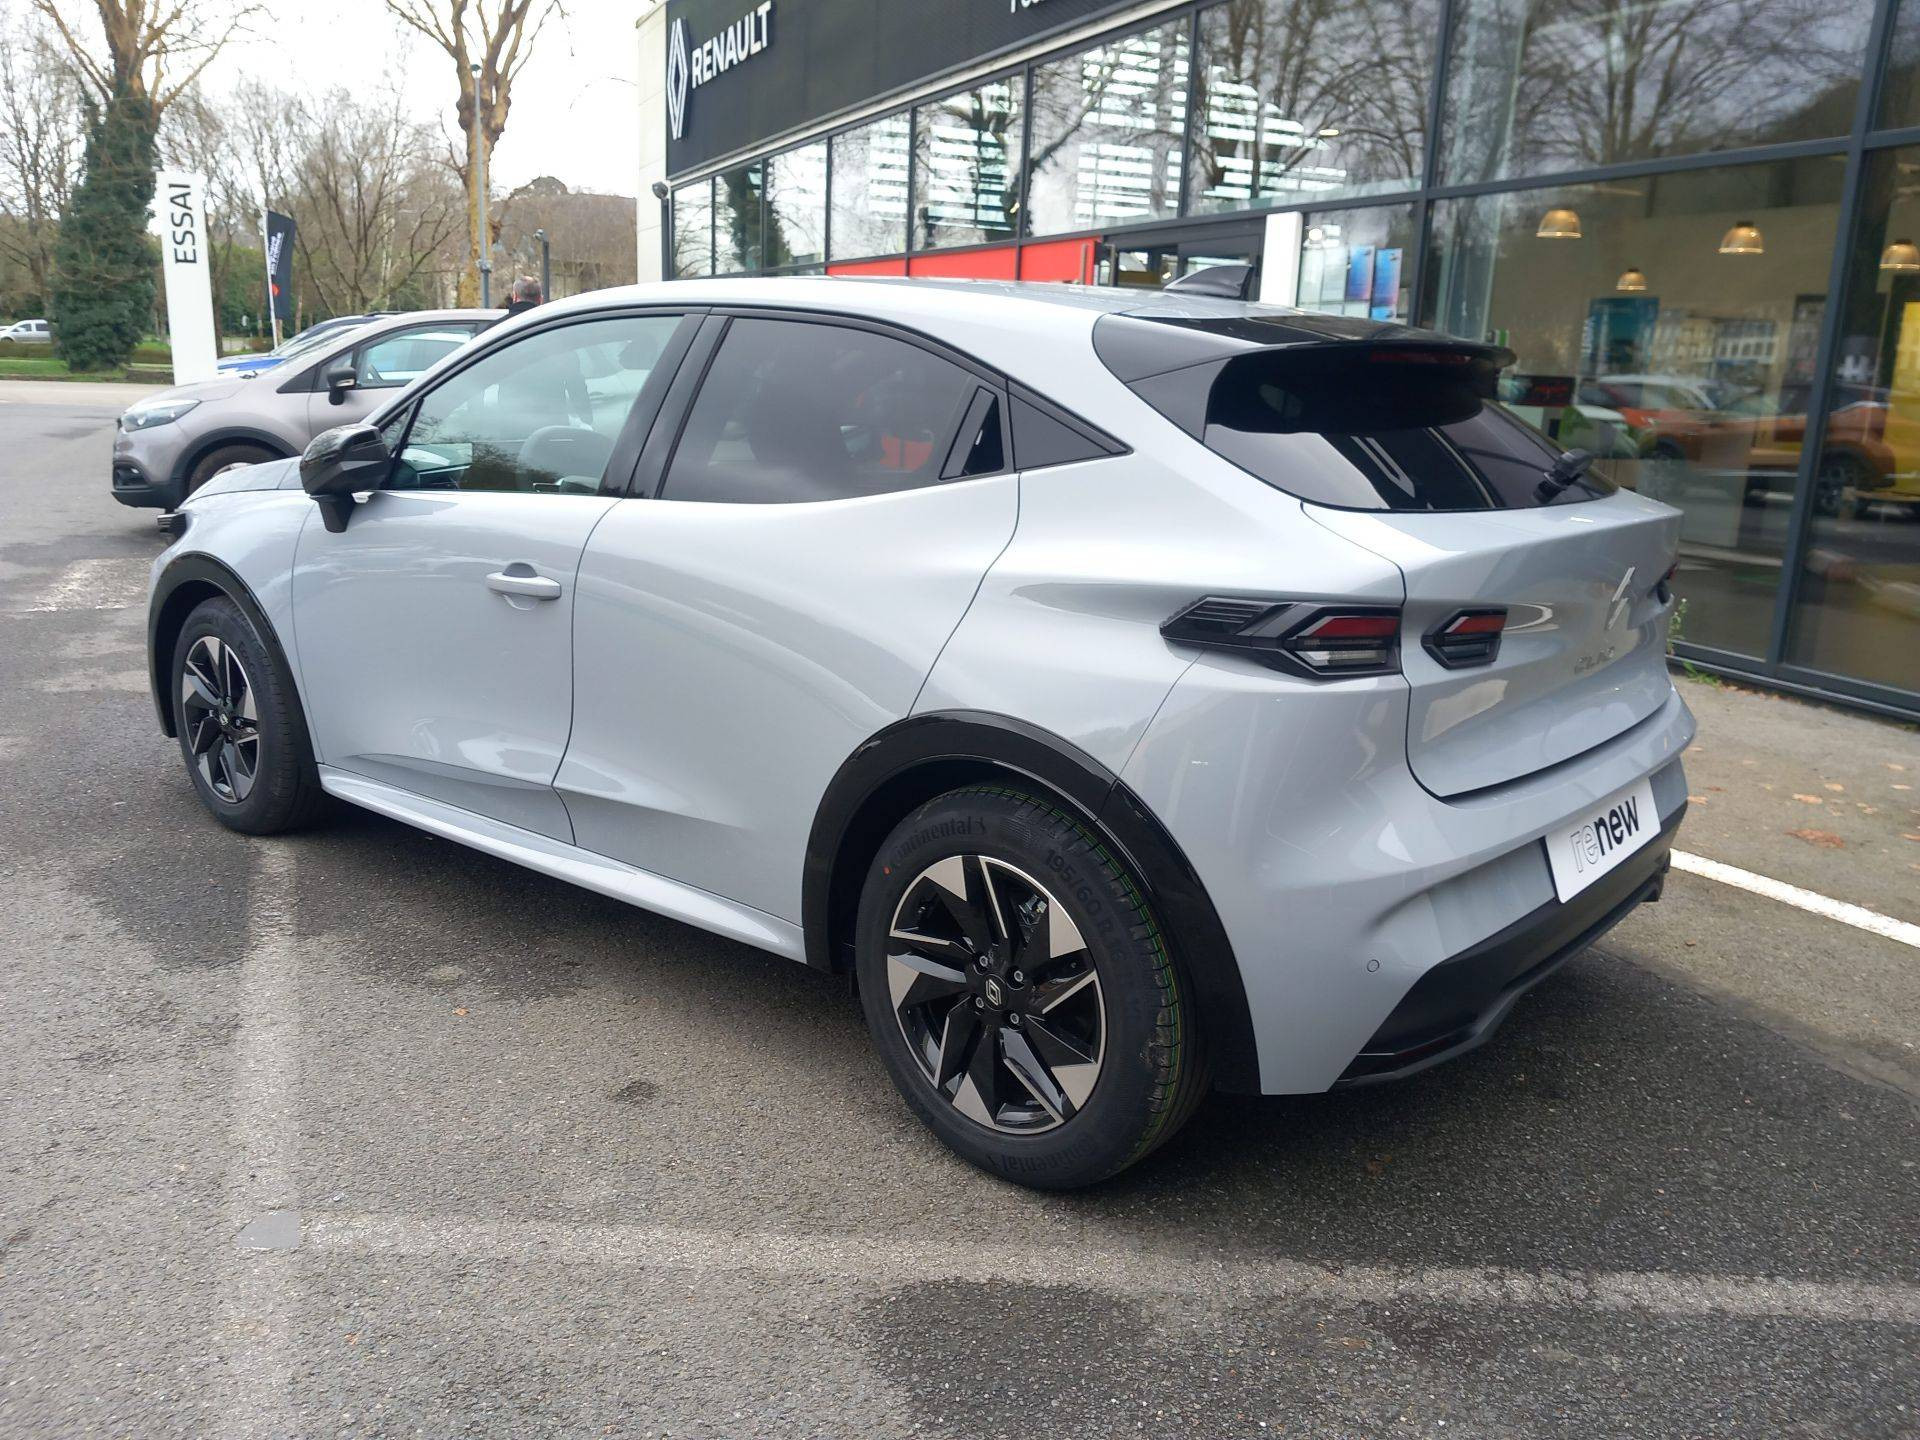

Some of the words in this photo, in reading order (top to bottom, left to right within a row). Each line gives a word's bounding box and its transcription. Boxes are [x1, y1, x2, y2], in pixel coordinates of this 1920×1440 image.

[692, 0, 771, 89] RENAULT
[168, 183, 197, 264] ESSAI
[1570, 796, 1639, 873] renew
